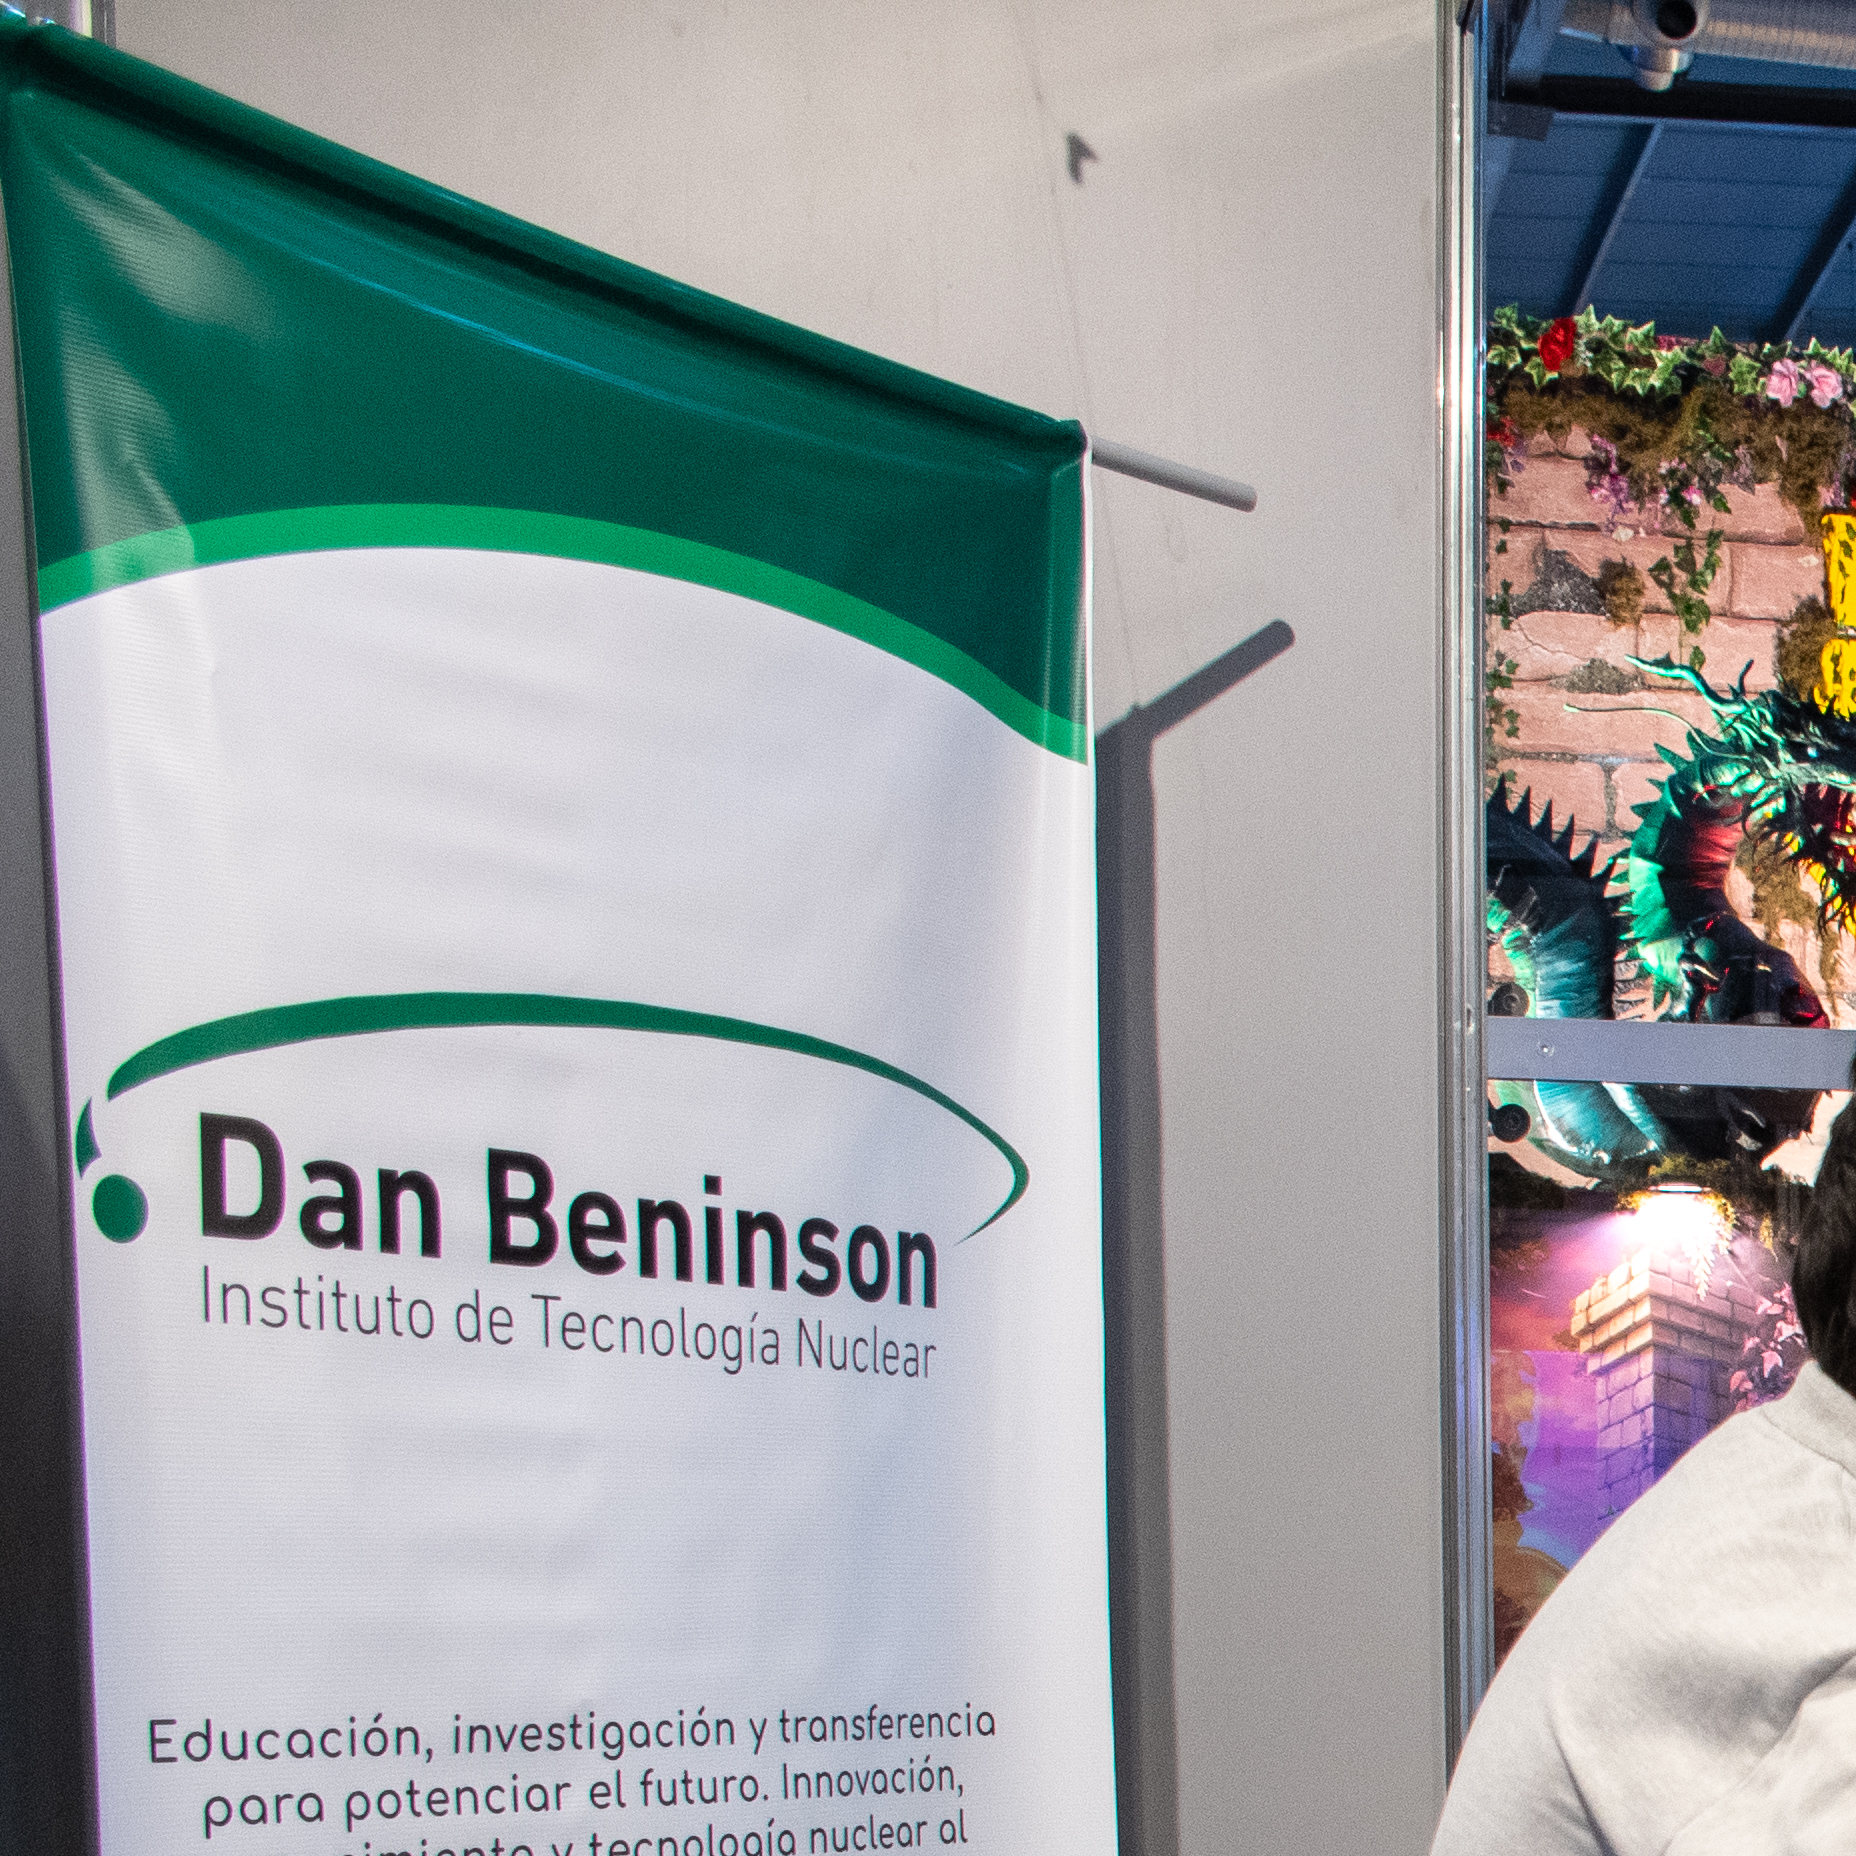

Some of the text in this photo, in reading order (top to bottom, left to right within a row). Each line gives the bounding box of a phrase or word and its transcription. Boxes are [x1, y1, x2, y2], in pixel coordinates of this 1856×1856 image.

[199, 1111, 938, 1310] Dan Beninson
[202, 1265, 937, 1379] Instituto de Tecnología Nuclear
[149, 1702, 997, 1765] Educación, investigación y transferencia
[203, 1756, 965, 1838] para potenciar el futuro. Innovación,
[809, 1814, 929, 1856] nuclear
[938, 1808, 970, 1847] al
